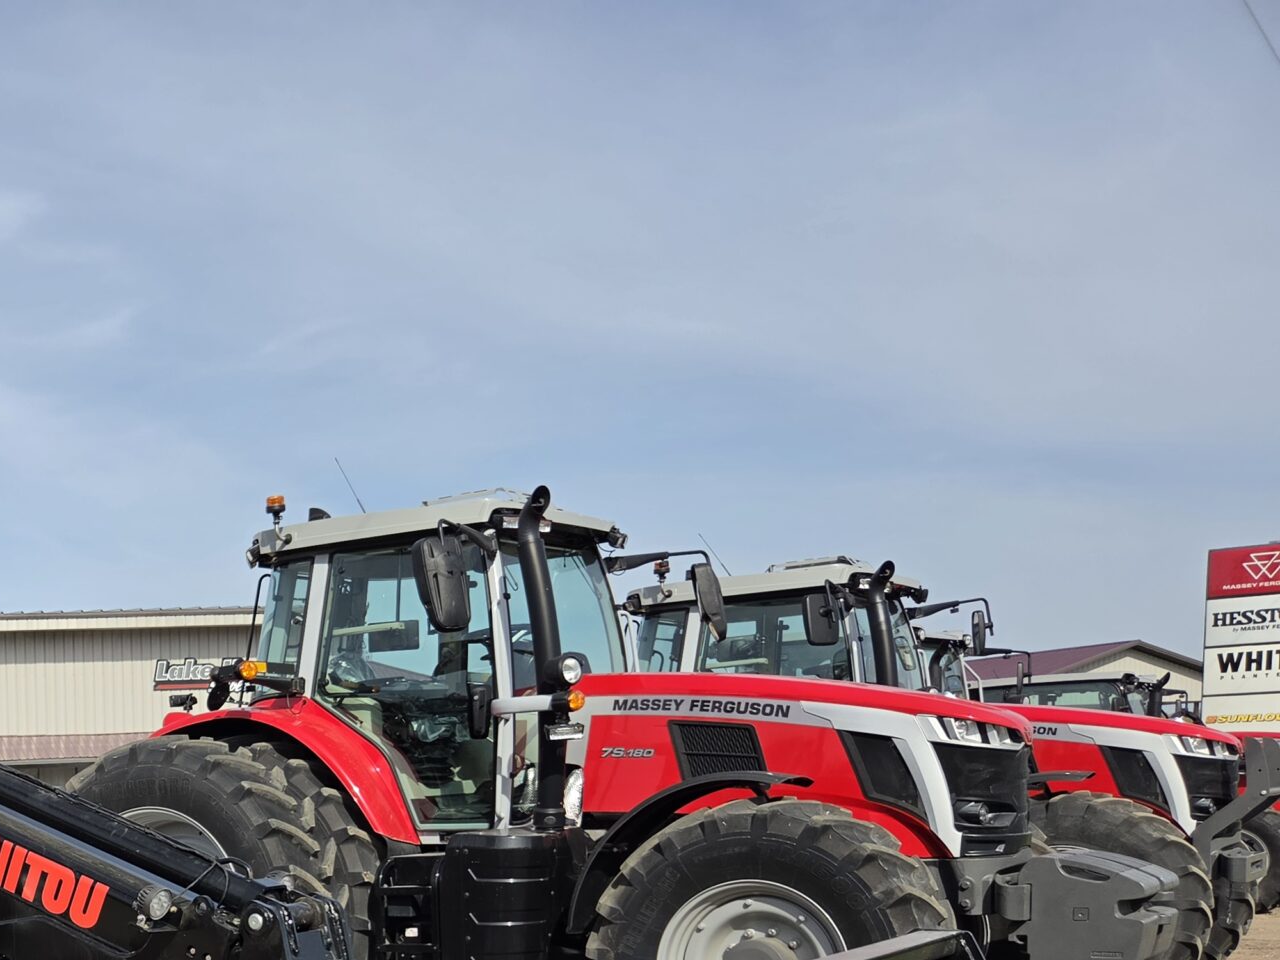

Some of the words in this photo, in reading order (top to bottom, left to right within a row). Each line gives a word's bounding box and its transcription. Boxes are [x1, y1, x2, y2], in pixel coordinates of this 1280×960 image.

[1222, 582, 1258, 590] MASSEY
[1212, 607, 1280, 627] HESST
[155, 658, 214, 682] Lake
[612, 699, 685, 711] MASSEY
[689, 699, 790, 718] FERGUSON
